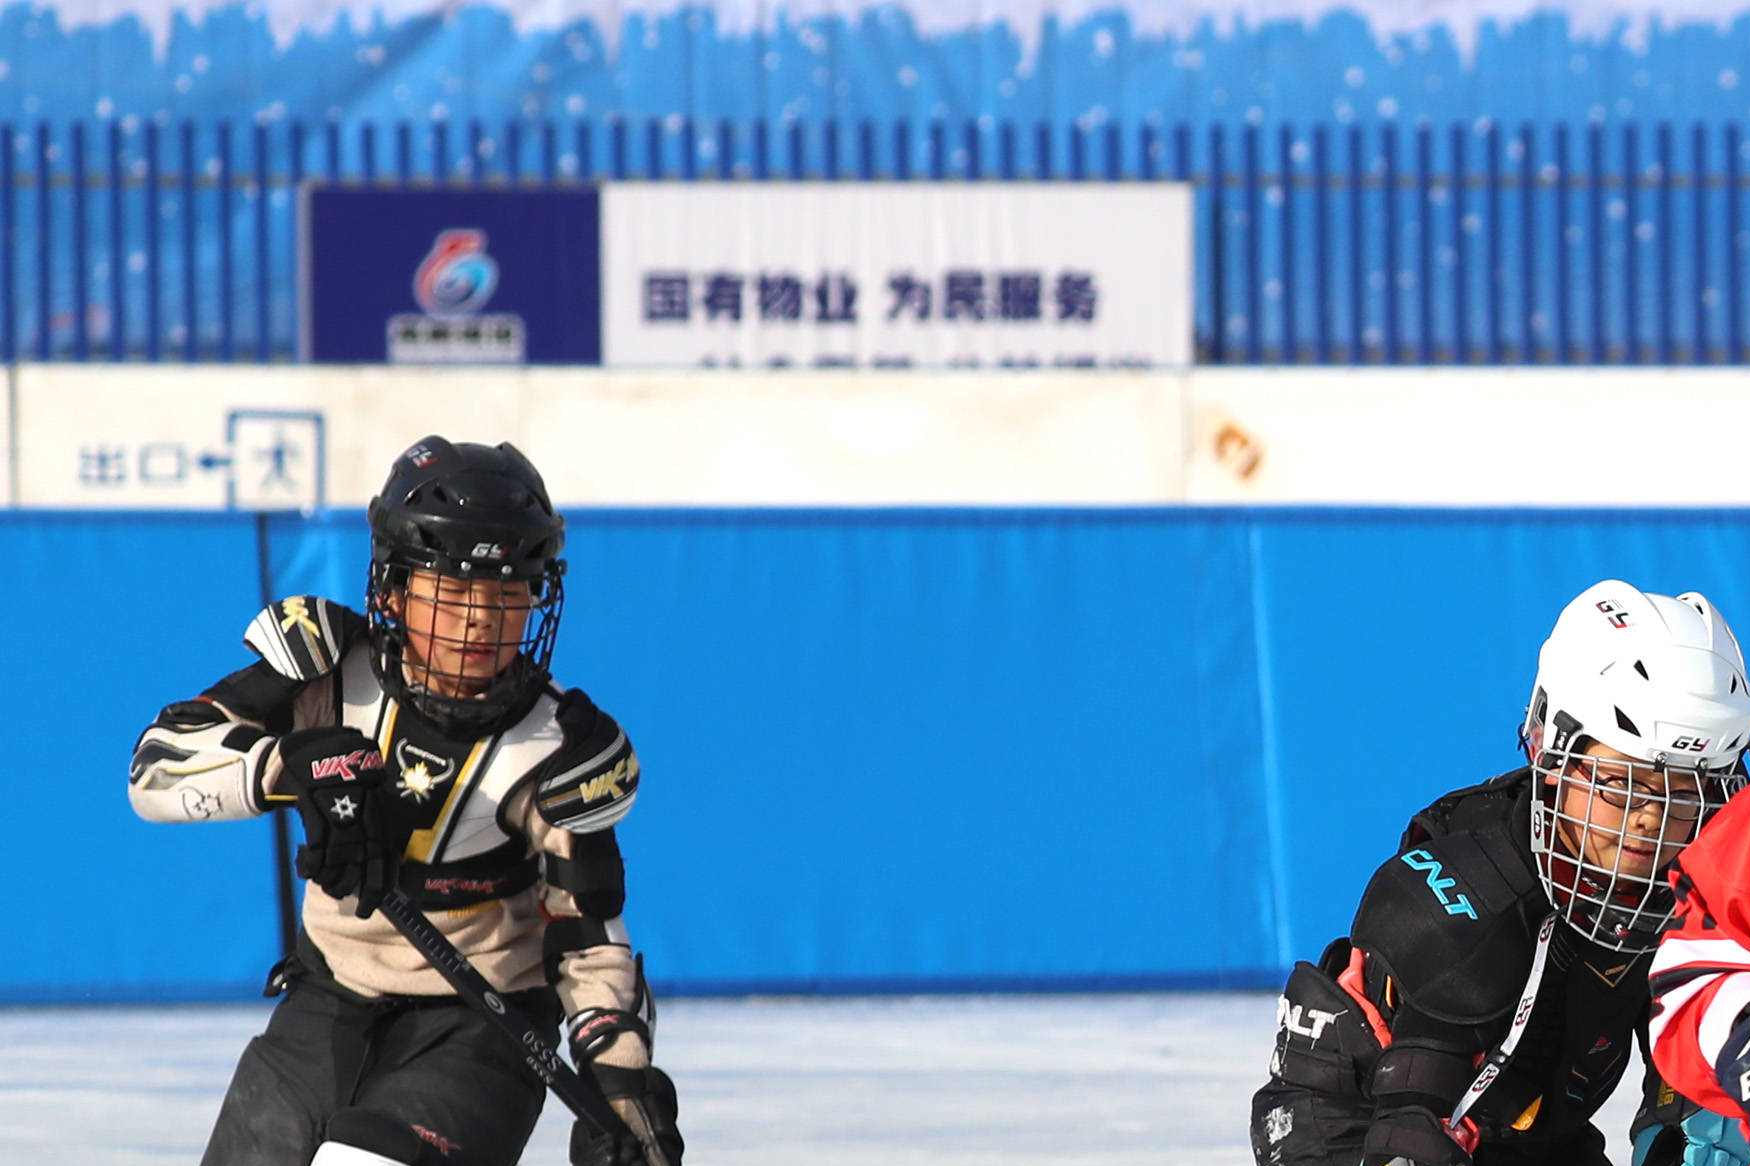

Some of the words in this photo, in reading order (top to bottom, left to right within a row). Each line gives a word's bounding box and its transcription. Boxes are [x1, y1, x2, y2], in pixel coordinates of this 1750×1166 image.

[643, 272, 858, 323] 国有物业
[884, 270, 1097, 323] 为民服务
[79, 444, 188, 488] 出口
[1671, 734, 1712, 753] GY
[522, 1030, 562, 1072] S550
